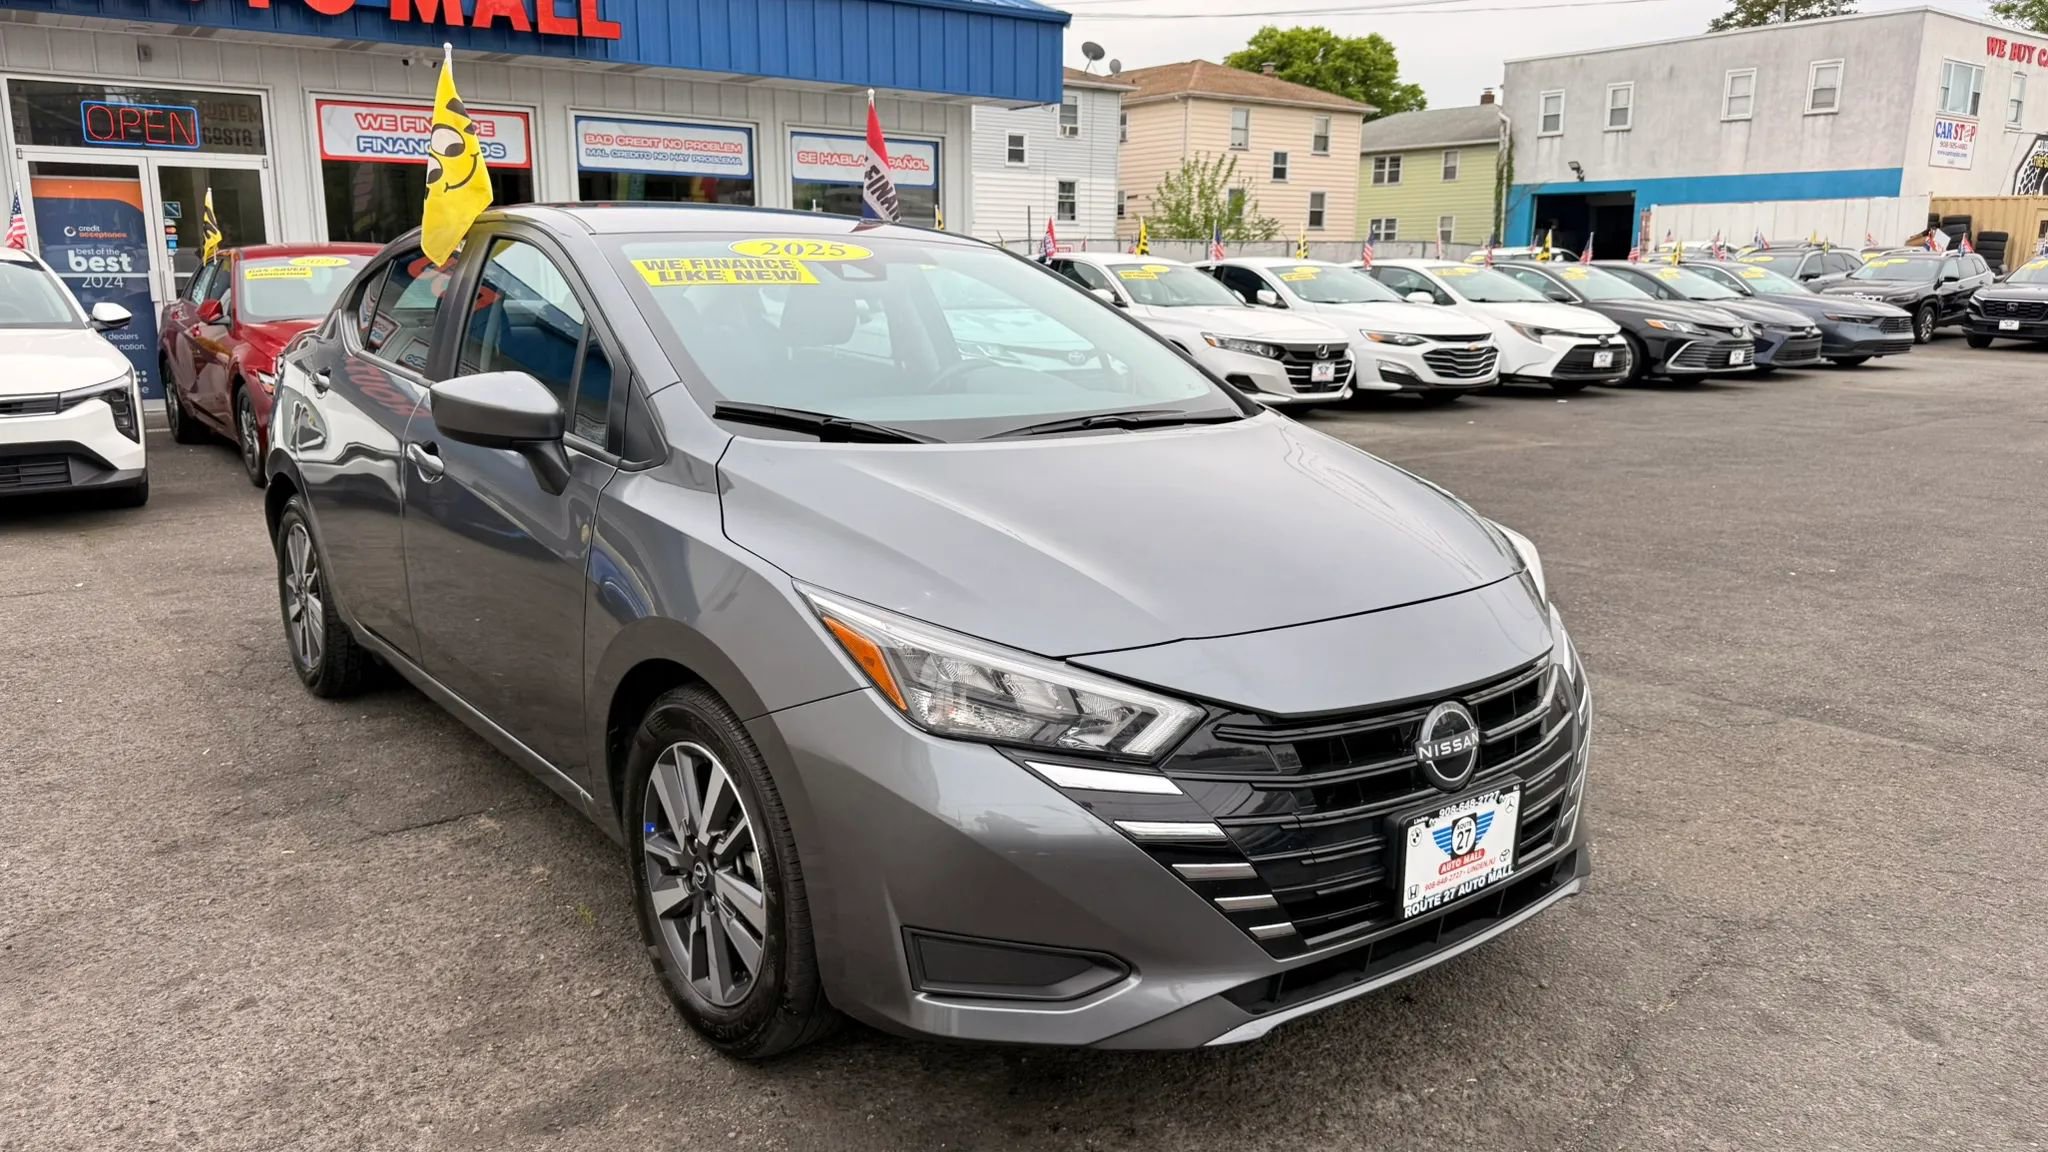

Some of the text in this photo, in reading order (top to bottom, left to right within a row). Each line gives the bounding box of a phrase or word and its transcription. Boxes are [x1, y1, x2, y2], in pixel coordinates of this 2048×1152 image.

[1987, 36, 2007, 58] WE
[2009, 43, 2037, 64] BUY
[86, 105, 196, 145] OPEN
[355, 113, 495, 137] WE FINCE
[1935, 121, 1953, 139] CAR
[584, 134, 744, 153] BAD CREDIT NO PROBLEM
[585, 148, 743, 166] MAL CREDITO NO HAY PROBLEMA
[797, 151, 817, 164] SE
[819, 153, 866, 167] HABLA
[888, 154, 929, 171] PAÑOL
[79, 231, 129, 240] acceptance
[75, 247, 120, 256] best of the
[760, 242, 846, 257] 2025
[67, 249, 133, 273] best
[641, 258, 796, 272] WE FINANCE
[81, 275, 125, 289] 2024
[658, 270, 801, 282] LIKE NEW
[108, 332, 139, 340] dealers
[1418, 733, 1479, 760] NISSAN
[1456, 820, 1473, 830] ROUTE
[1456, 828, 1472, 851] 27
[1440, 852, 1481, 874] AUTO MALL
[1404, 865, 1514, 918] ROUTE 27 AUTO MALL
